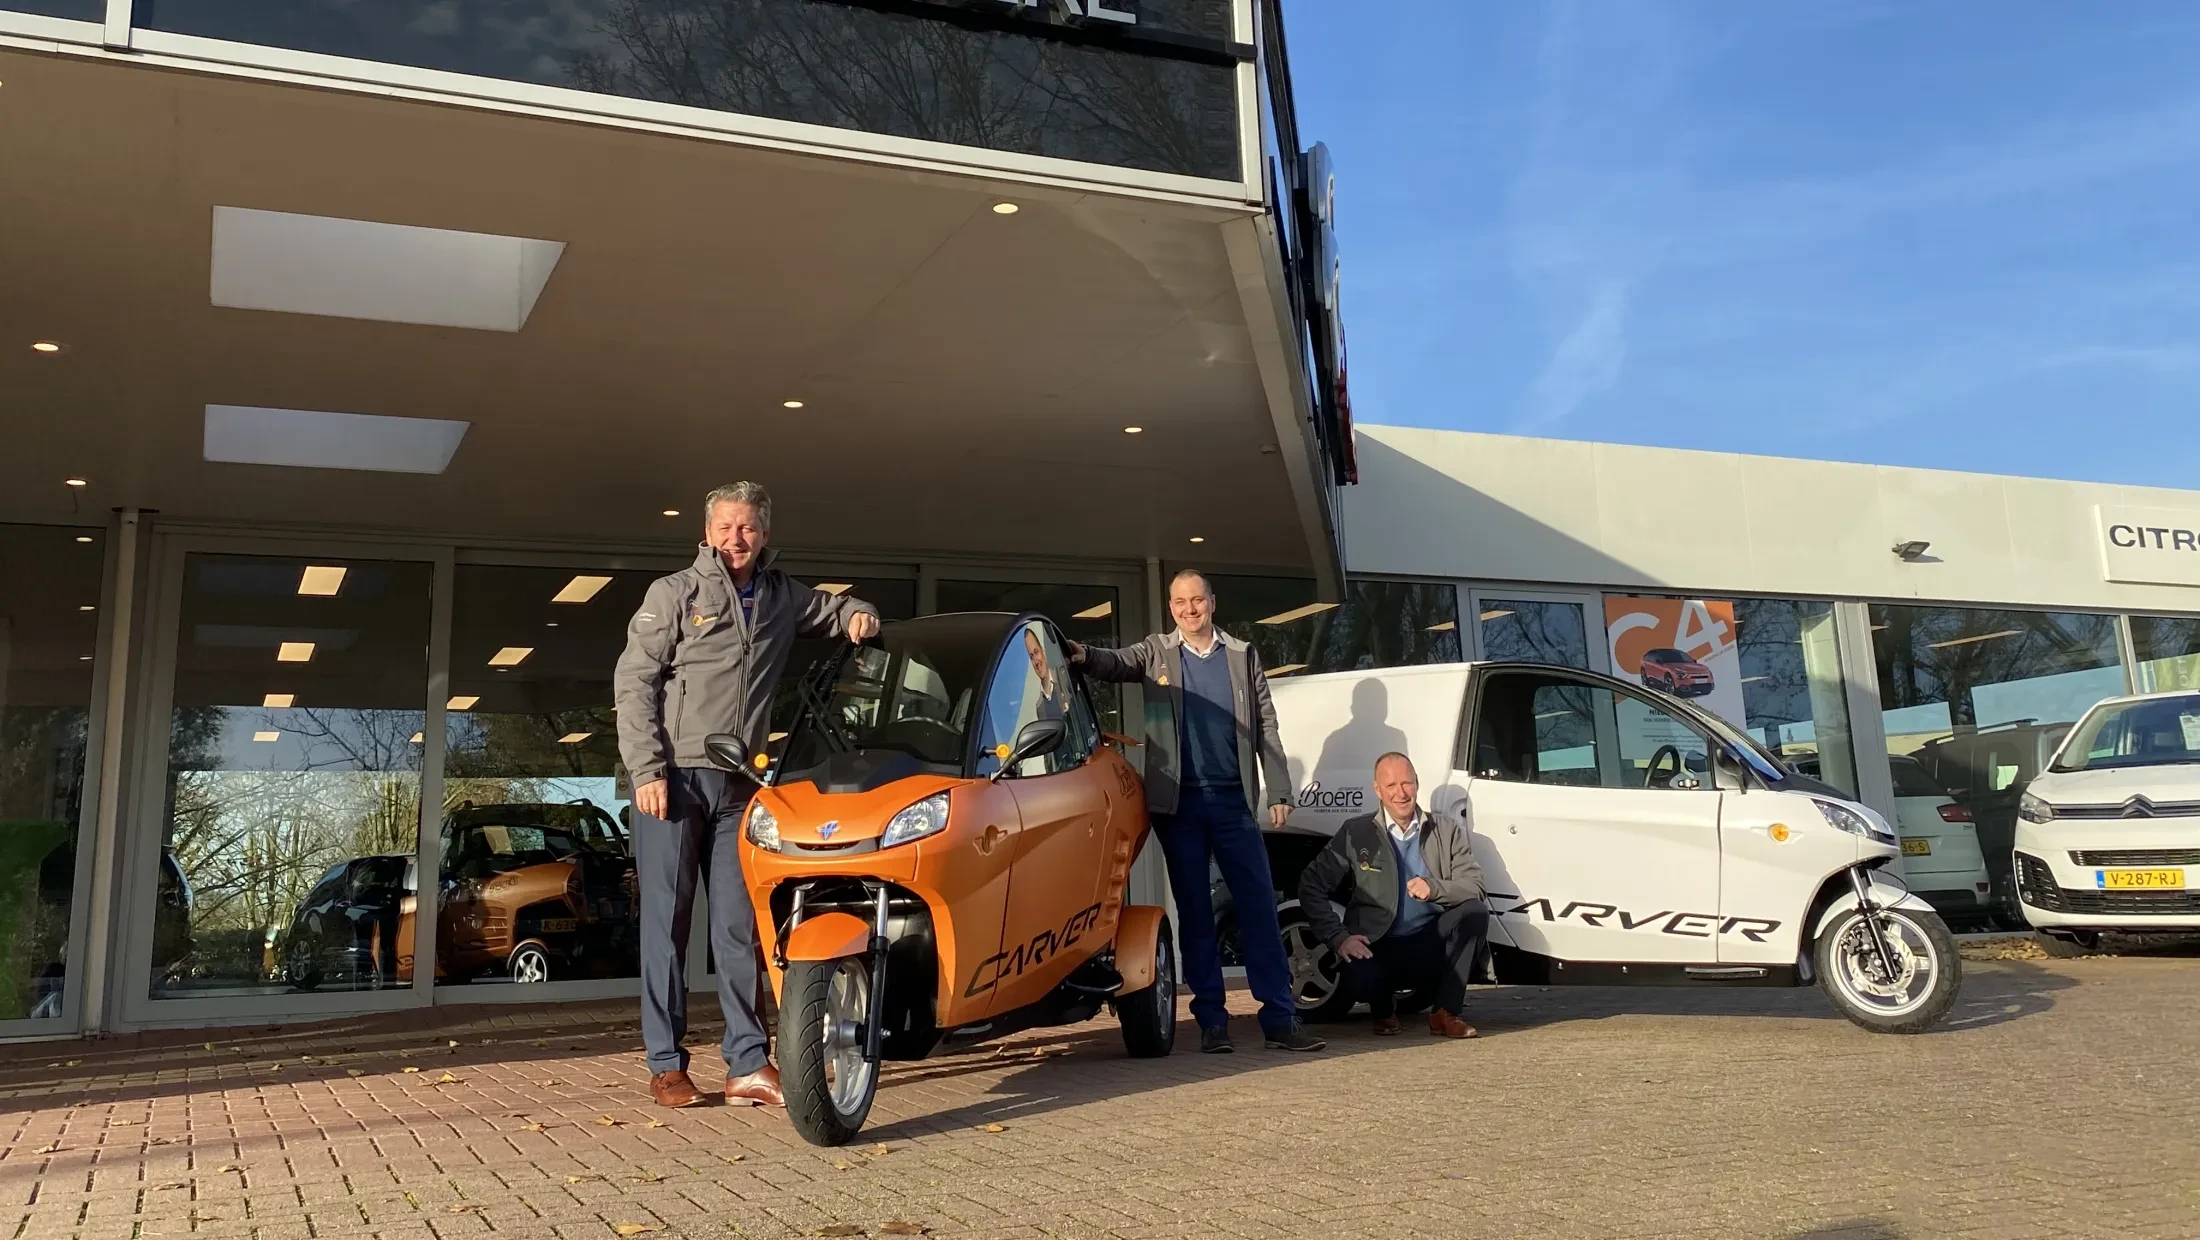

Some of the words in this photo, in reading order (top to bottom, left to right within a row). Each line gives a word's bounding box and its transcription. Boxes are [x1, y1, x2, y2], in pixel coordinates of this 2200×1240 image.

[2109, 524, 2200, 551] CITR
[1298, 781, 1363, 807] Broere
[2110, 873, 2177, 885] V-287-RJ
[964, 902, 1102, 998] CARVER
